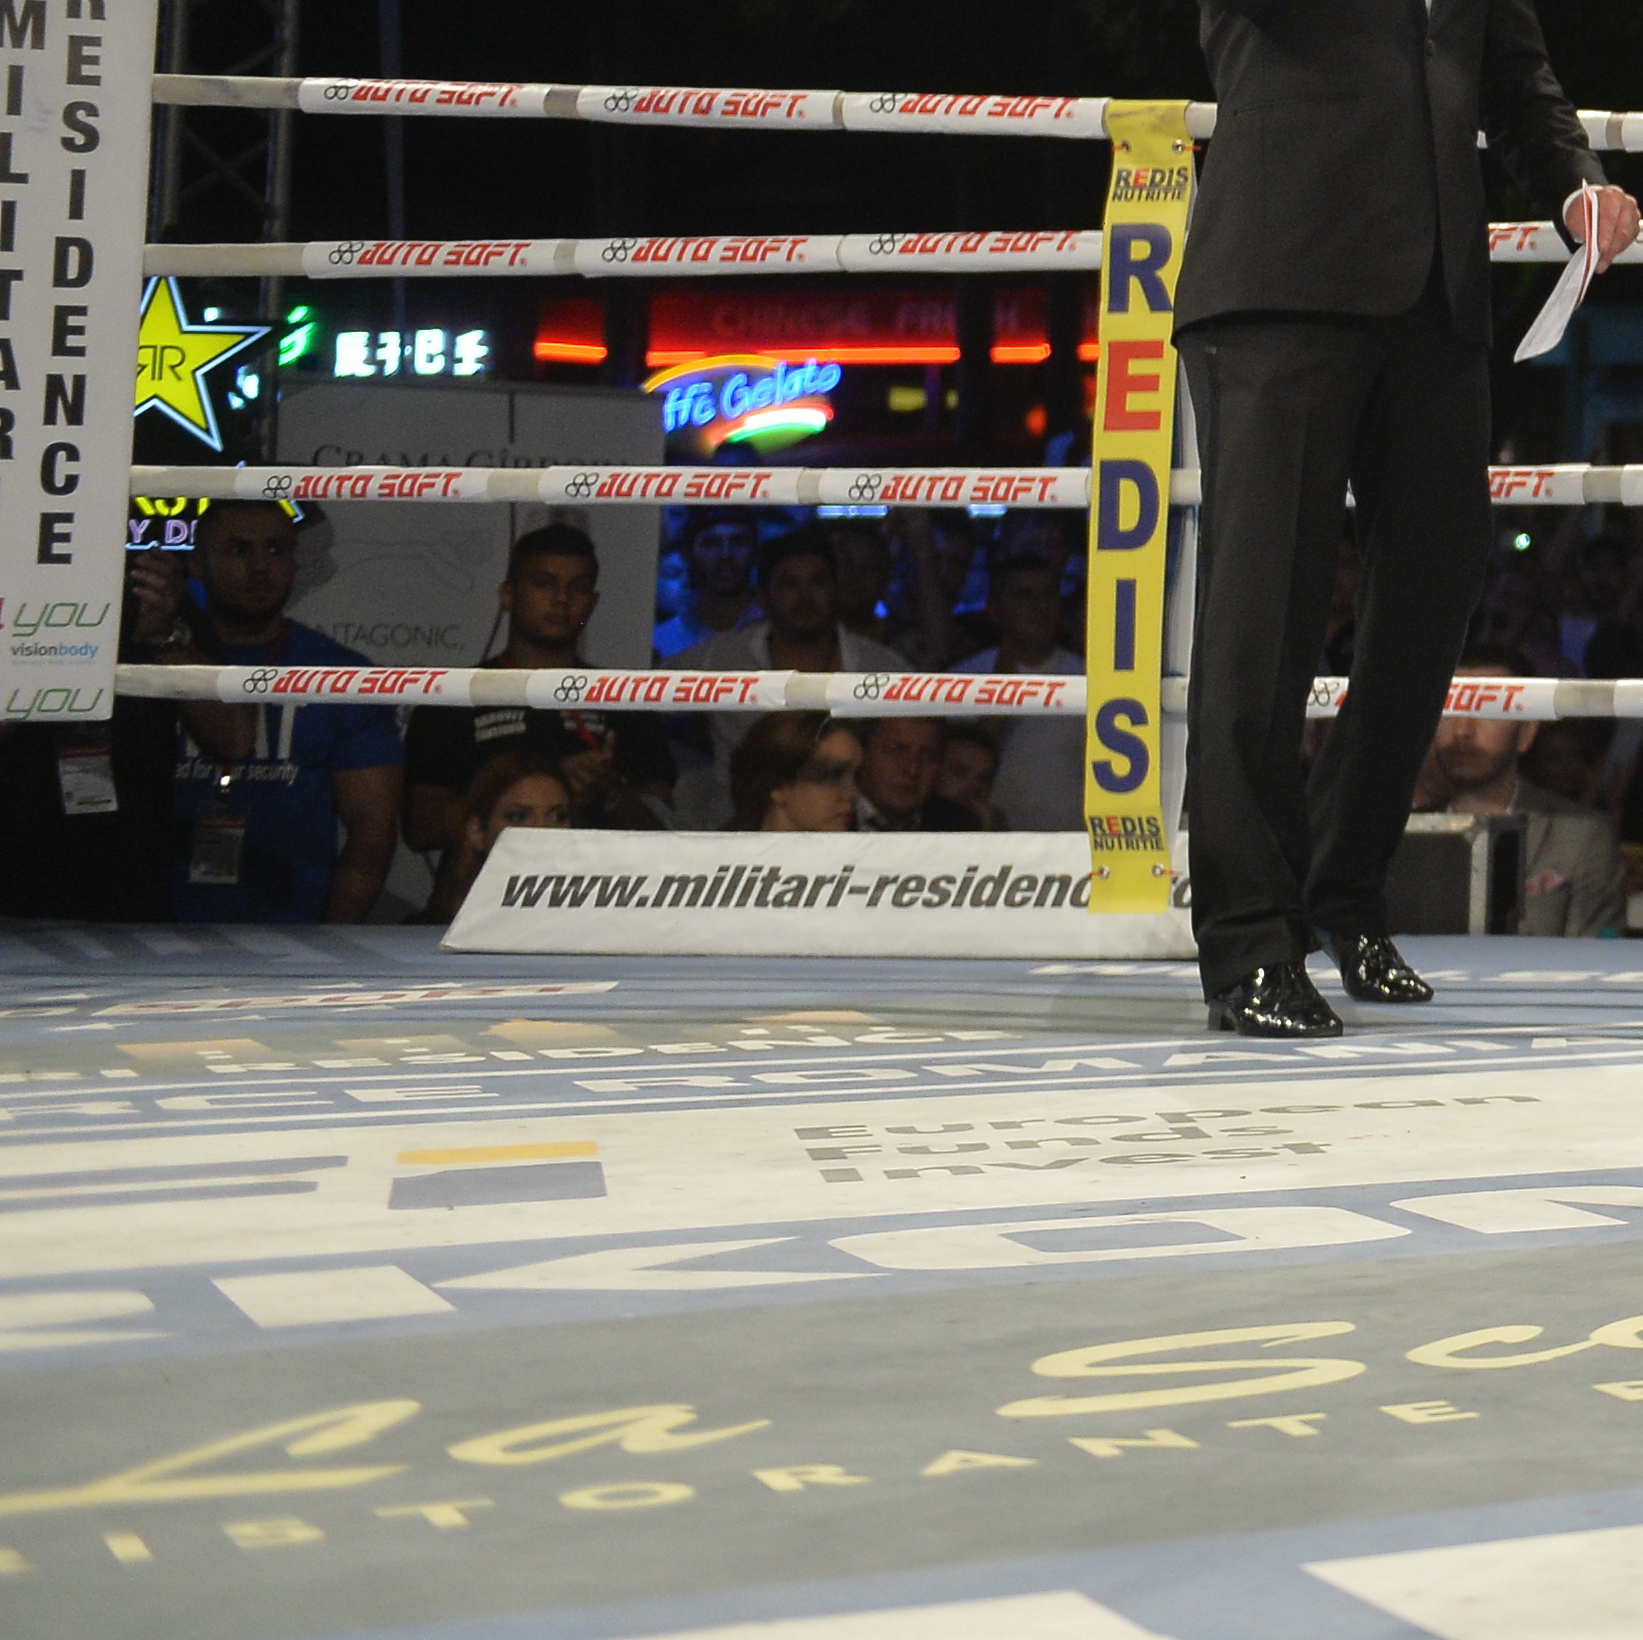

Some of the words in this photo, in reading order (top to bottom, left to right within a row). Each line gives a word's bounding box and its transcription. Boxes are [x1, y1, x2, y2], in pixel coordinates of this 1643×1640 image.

[1116, 167, 1188, 187] REDIS
[720, 357, 843, 421] Gelato
[1092, 222, 1174, 795] REDIS
[11, 643, 99, 659] visionbody
[1089, 816, 1161, 836] REDIS
[793, 1093, 1543, 1141] European
[804, 1123, 1297, 1162] Funds
[819, 1141, 1333, 1184] Invest
